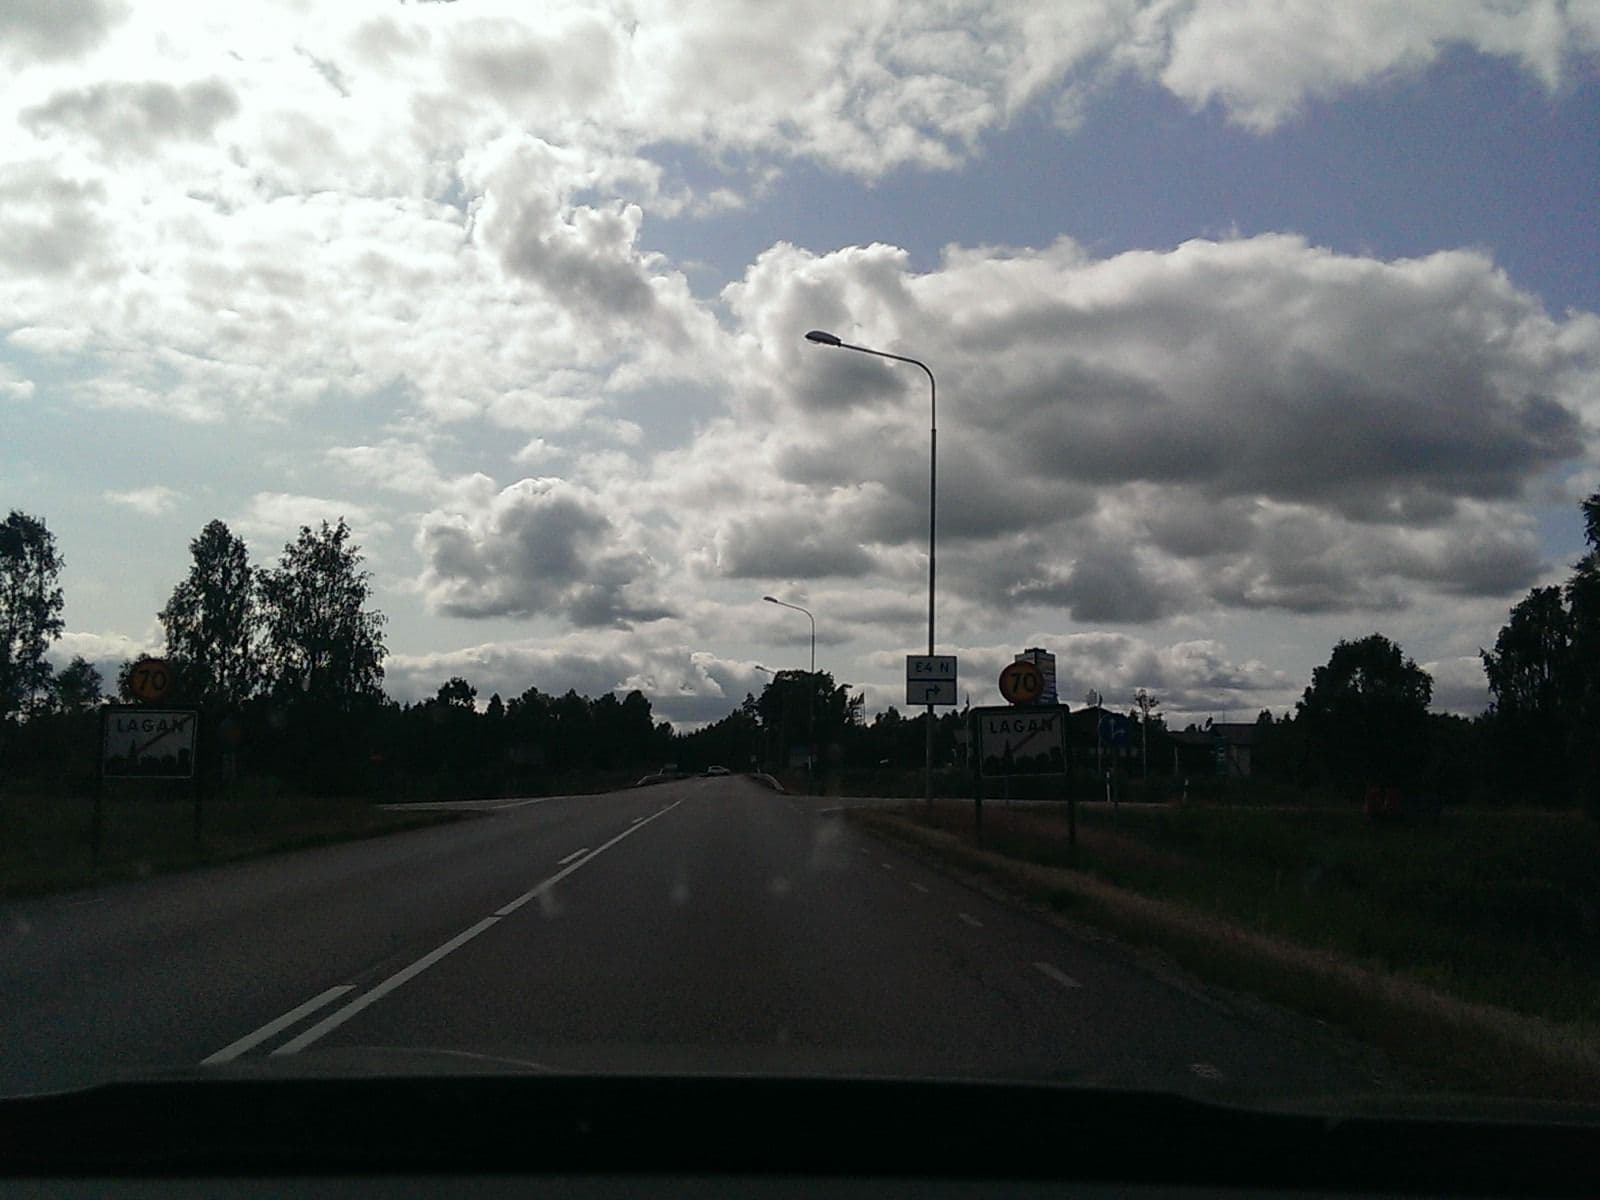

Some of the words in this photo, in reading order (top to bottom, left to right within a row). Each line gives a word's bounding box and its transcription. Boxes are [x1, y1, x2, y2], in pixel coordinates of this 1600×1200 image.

[915, 662, 932, 673] E4
[940, 662, 949, 673] N
[138, 670, 167, 690] 70
[1010, 672, 1038, 693] 70
[117, 719, 184, 733] LAGAN
[989, 719, 1053, 734] LAGAN
